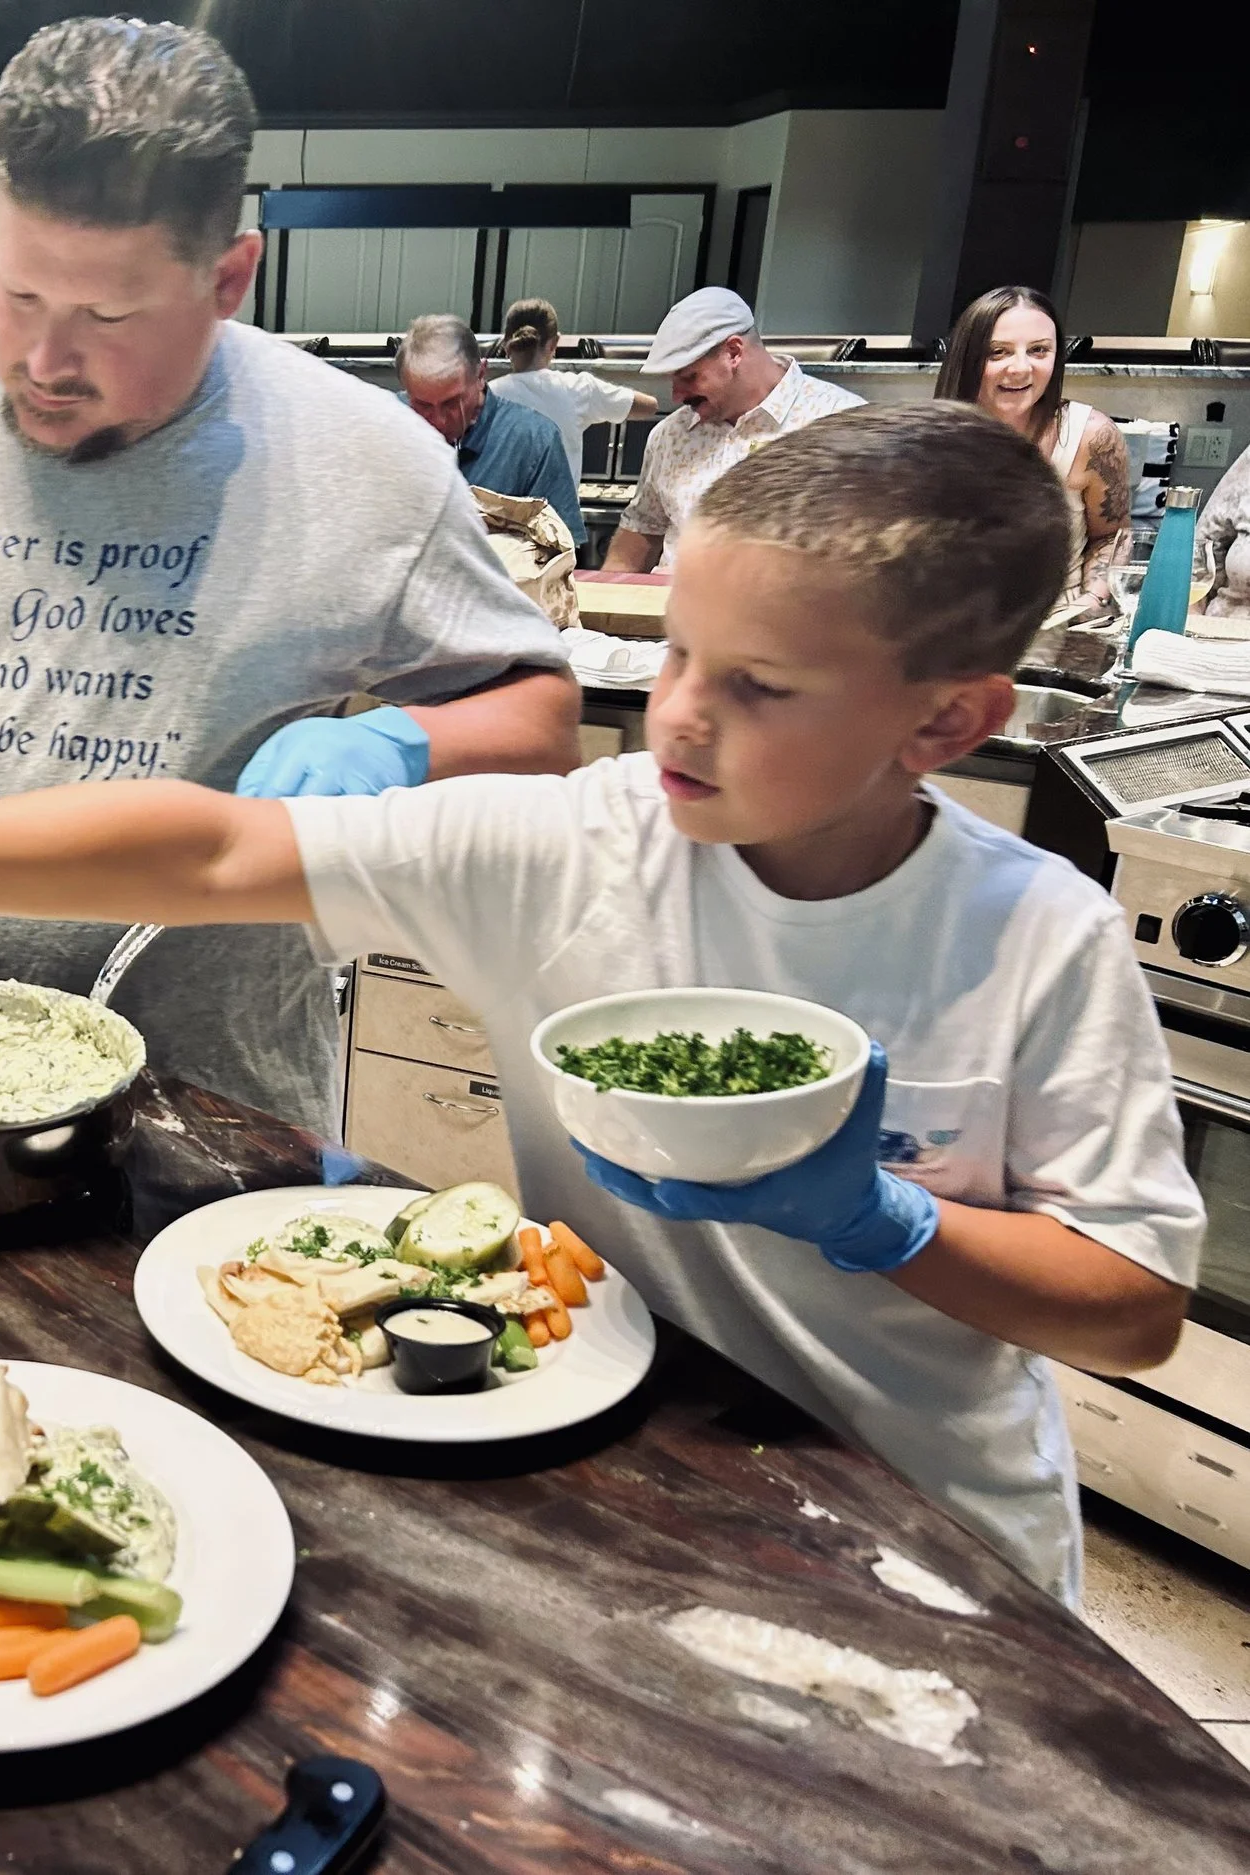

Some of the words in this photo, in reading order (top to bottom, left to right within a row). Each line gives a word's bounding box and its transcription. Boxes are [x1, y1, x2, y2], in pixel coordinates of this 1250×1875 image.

[54, 530, 84, 567] is
[87, 535, 211, 589] proof
[12, 588, 86, 641] God
[100, 595, 197, 637] loves
[45, 666, 154, 700] wants
[378, 957, 389, 965] Ice
[389, 959, 411, 969] Cream
